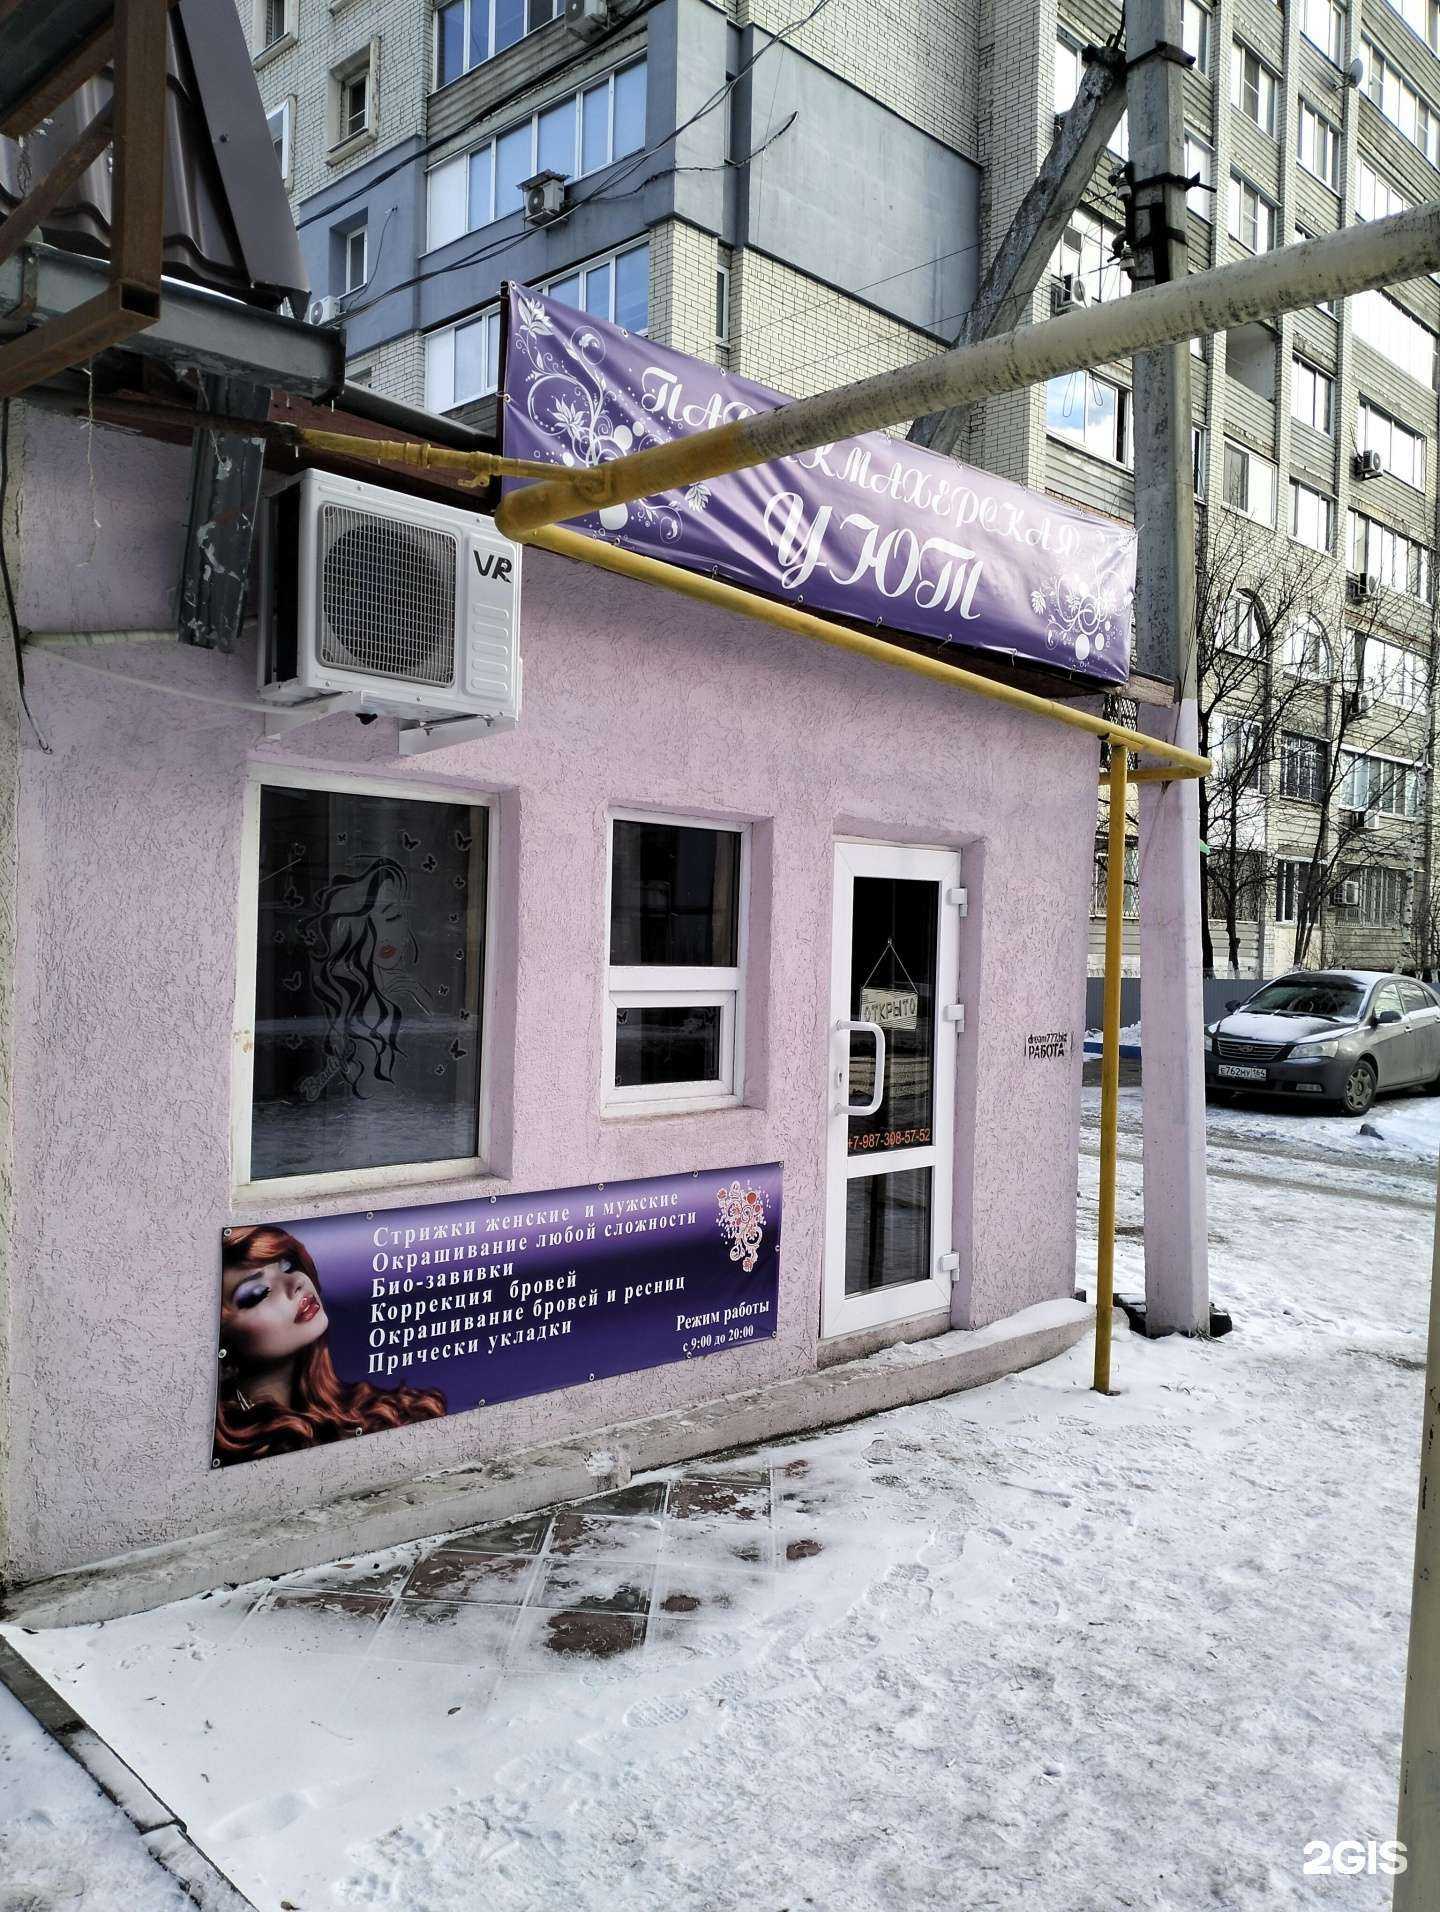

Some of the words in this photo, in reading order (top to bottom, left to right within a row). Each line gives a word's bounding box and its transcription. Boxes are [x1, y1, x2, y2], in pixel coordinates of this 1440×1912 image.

[641, 366, 1081, 556] ПАКМАХЕРСКАЯ
[473, 549, 513, 584] VR
[764, 491, 984, 620] УЮТ
[864, 998, 916, 1022] ОТКРЫТО
[1029, 1043, 1065, 1060] РАБОТА
[372, 1237, 528, 1273] Окрашивание
[535, 1223, 596, 1248] любой
[604, 1211, 697, 1237] сложности
[373, 1220, 475, 1248] Стрижки
[486, 1207, 570, 1231] женские
[585, 1204, 594, 1218] и
[602, 1192, 679, 1218] мужские
[371, 1262, 514, 1298] Био-завивки
[371, 1289, 493, 1323] Коррекция
[509, 1271, 577, 1301] бровей
[369, 1306, 524, 1348] Окрашивание
[532, 1289, 599, 1320] бровей
[607, 1289, 617, 1303] и
[624, 1276, 685, 1304] ресниц
[675, 1311, 720, 1332] Режим
[723, 1301, 770, 1325] работы
[368, 1338, 479, 1375] Прически
[487, 1320, 572, 1354] укладки
[682, 1342, 689, 1352] с
[691, 1334, 712, 1351] 9:00
[714, 1334, 726, 1346] до
[728, 1325, 754, 1342] 20:00
